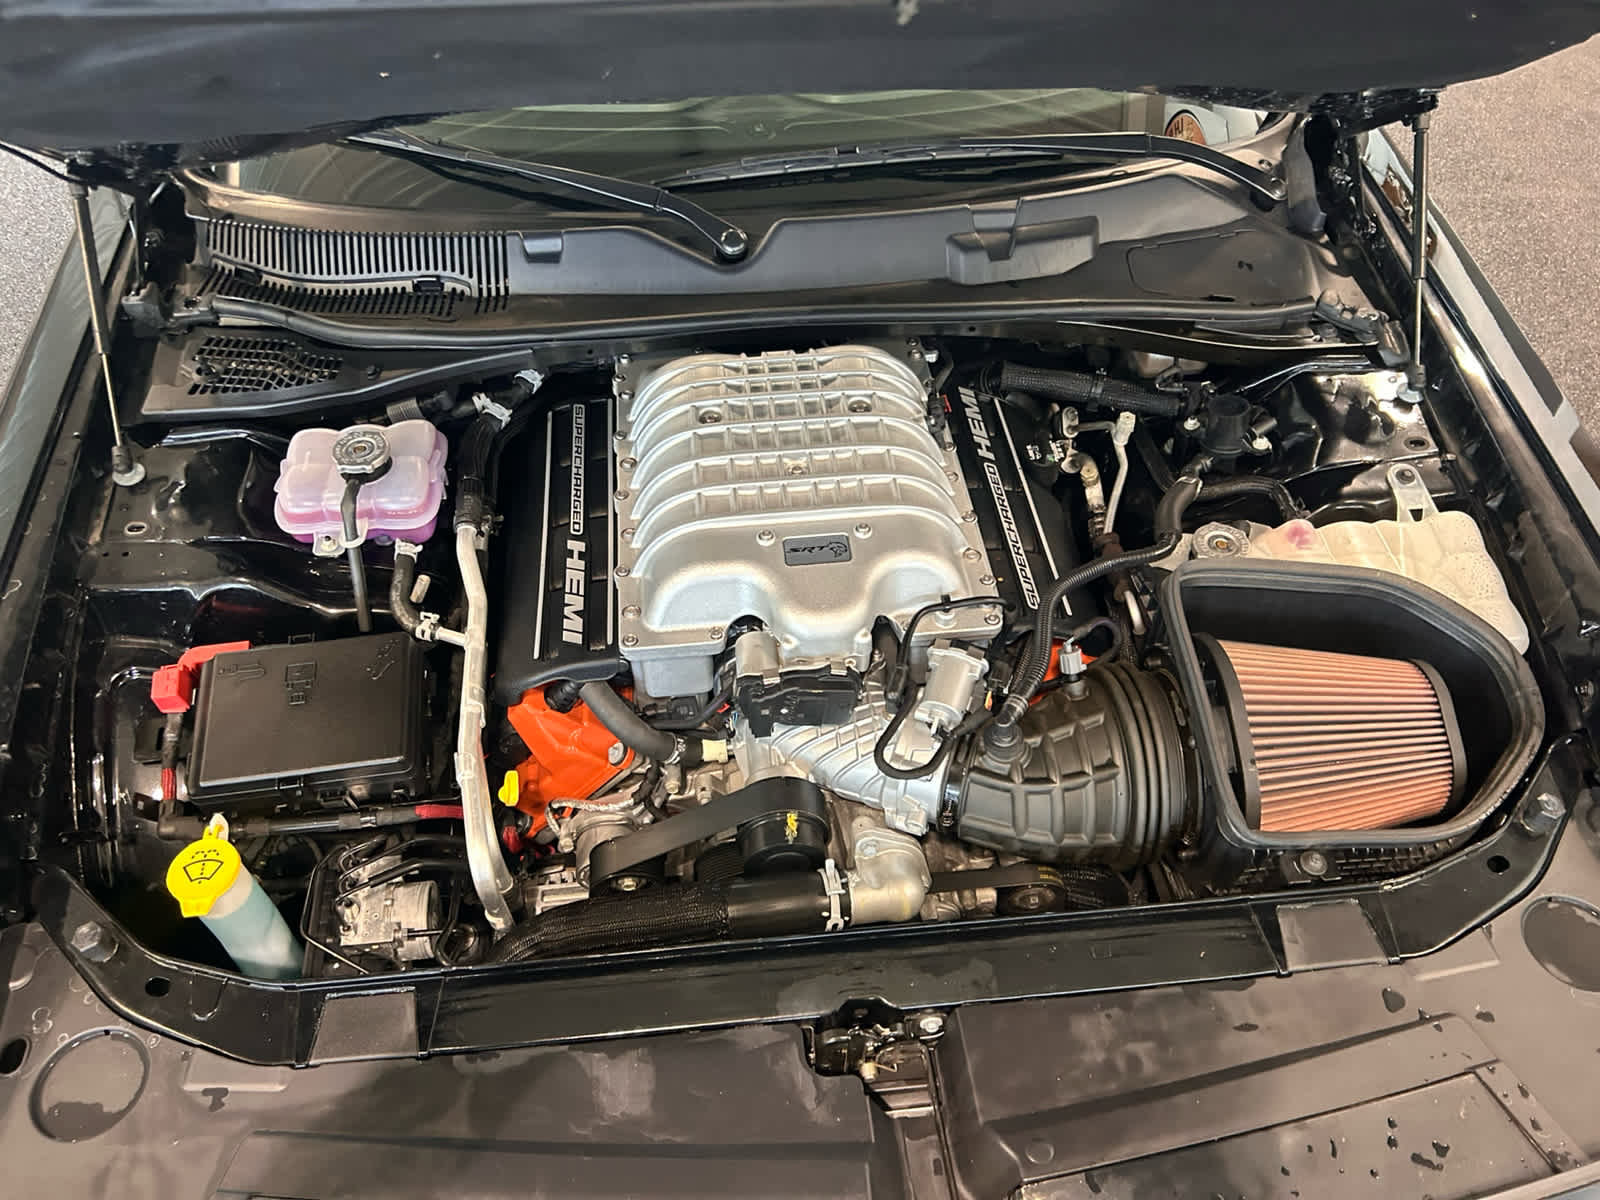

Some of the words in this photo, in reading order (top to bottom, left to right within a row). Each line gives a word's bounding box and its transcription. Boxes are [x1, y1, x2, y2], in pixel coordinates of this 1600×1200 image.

[572, 404, 585, 534] SUPERCHARGED
[958, 386, 996, 461] HEMI
[562, 539, 586, 645] HEMI
[986, 464, 1038, 609] SUPERCHARGED
